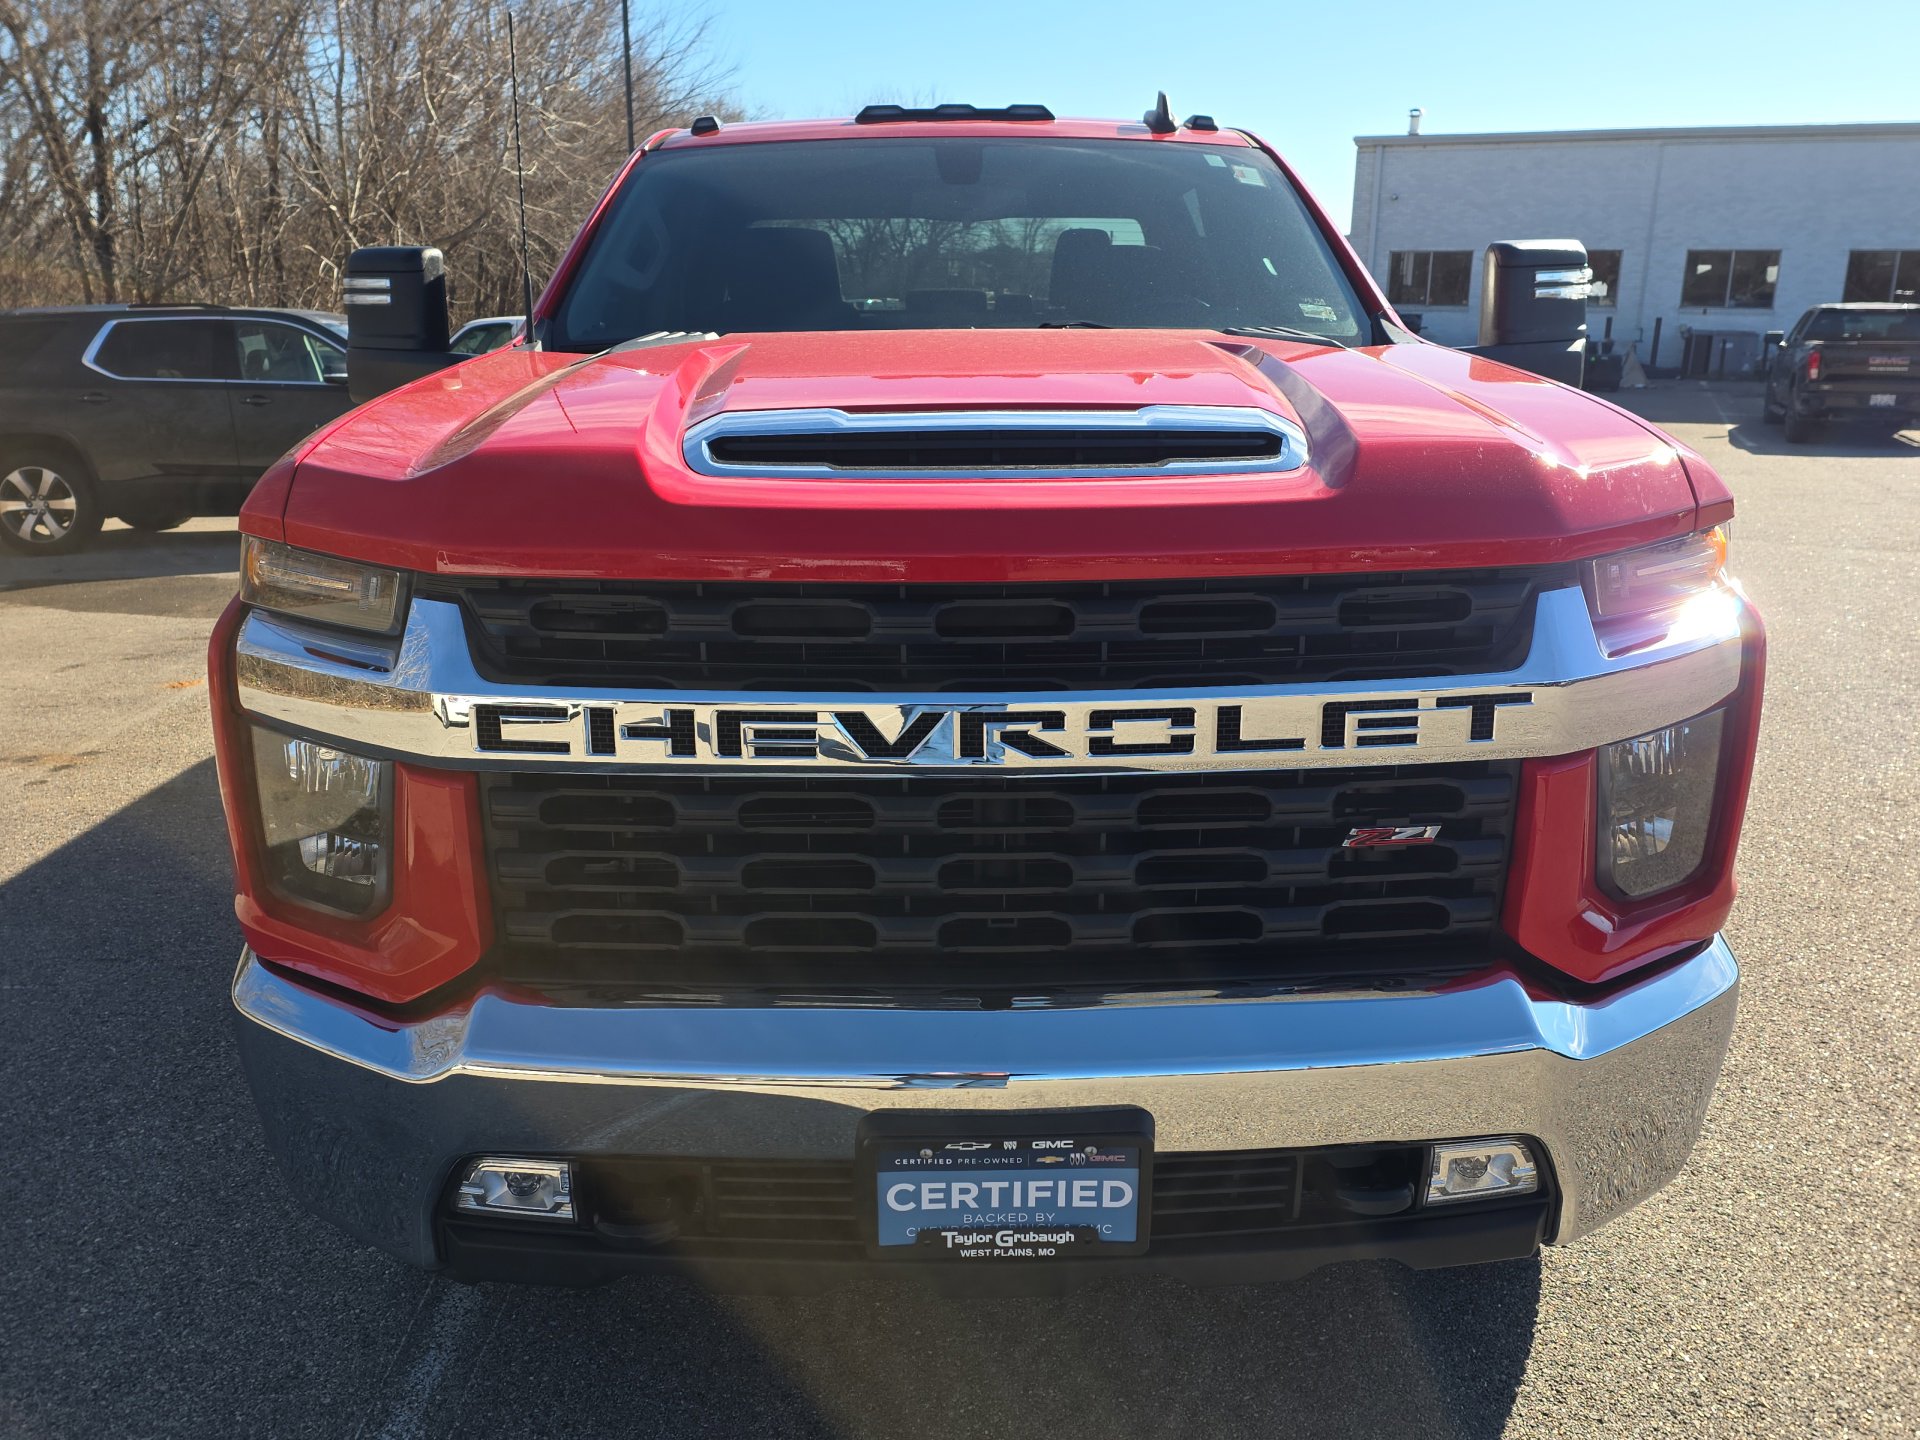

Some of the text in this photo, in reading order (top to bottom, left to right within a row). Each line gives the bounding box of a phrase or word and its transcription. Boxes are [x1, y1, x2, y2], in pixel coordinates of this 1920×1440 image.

[470, 691, 1535, 760] CHEVROLET
[1342, 825, 1442, 847] Z71
[1031, 1140, 1074, 1149] GMC
[957, 1157, 1023, 1165] PRE-OWNED
[886, 1180, 1133, 1212] CERTIFIED
[963, 1212, 1056, 1224] BACKED BY
[941, 1231, 993, 1249] Taylor
[995, 1230, 1075, 1247] Grubaugh
[960, 1248, 1056, 1258] WEST PLAINS, MO
